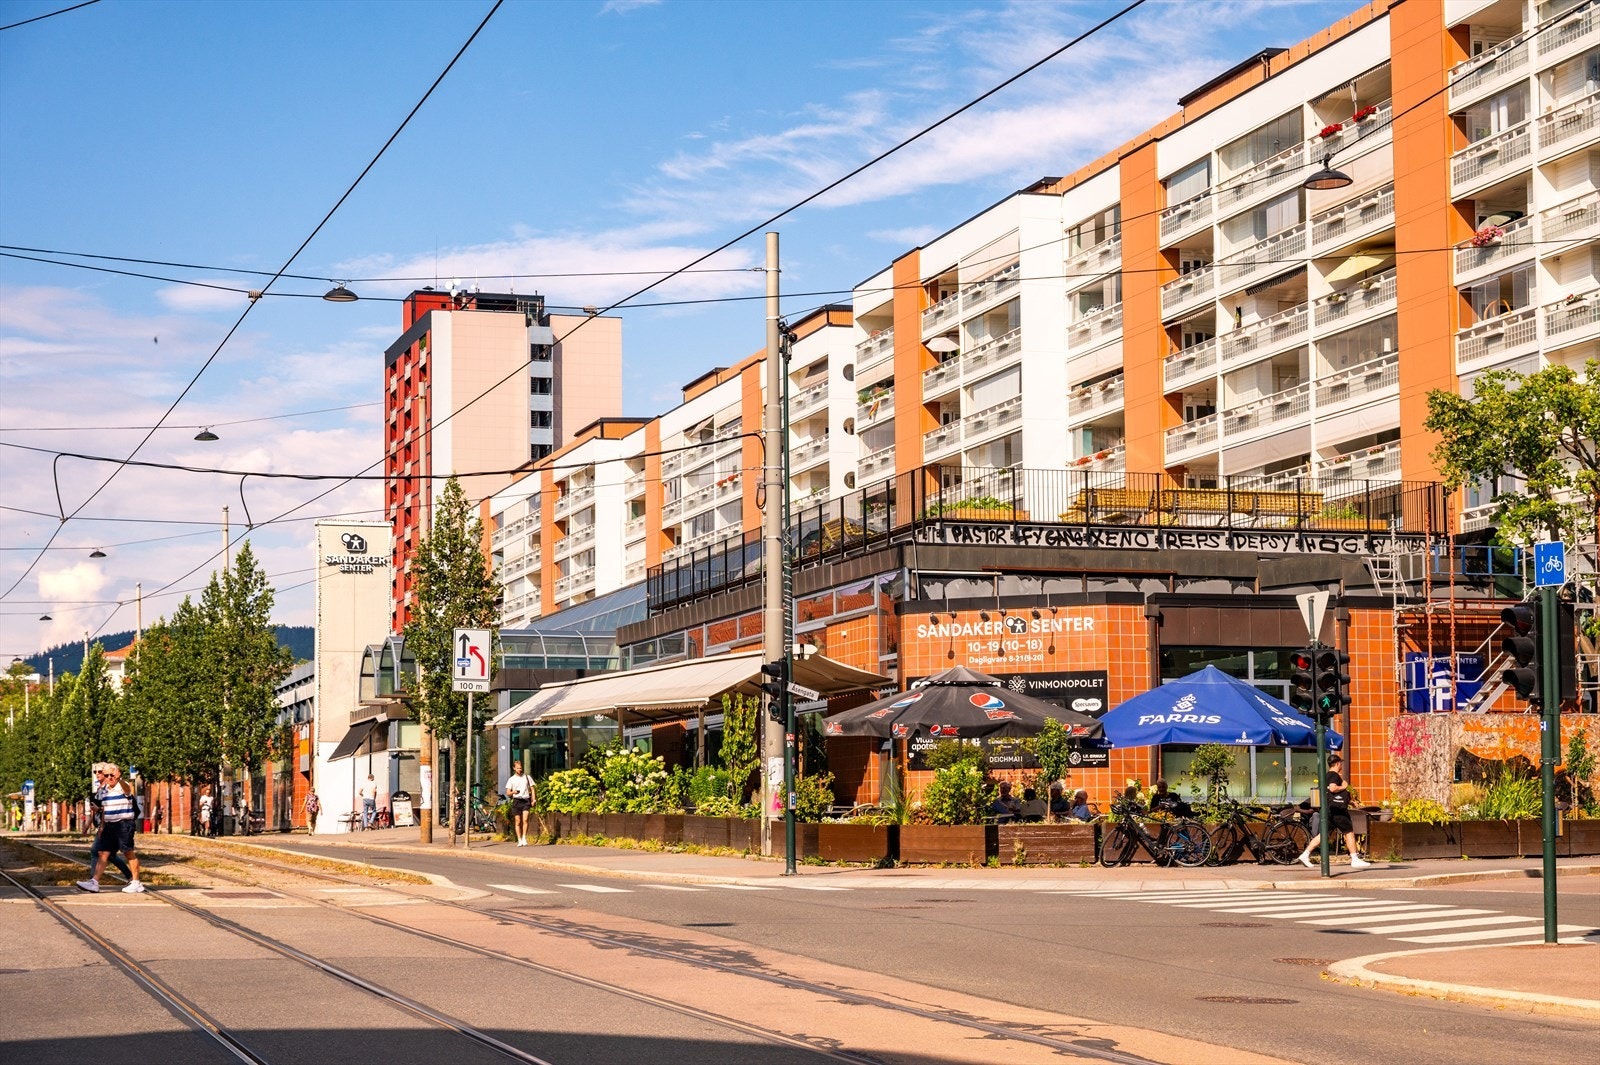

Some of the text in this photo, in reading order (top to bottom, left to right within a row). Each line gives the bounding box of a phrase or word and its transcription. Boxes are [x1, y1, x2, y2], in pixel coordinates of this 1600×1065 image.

[951, 525, 1007, 544] PASTOR
[1089, 528, 1149, 548] XENO
[1165, 532, 1220, 549] REPS
[1232, 533, 1291, 550] DEPSY
[325, 555, 387, 565] SANDAKER
[340, 564, 373, 573] SENTER
[917, 616, 1094, 638] SANDAKER SENTER
[967, 641, 999, 652] 10-19
[1028, 679, 1104, 689] VINMONOPOLET
[1138, 712, 1221, 726] FARRIS
